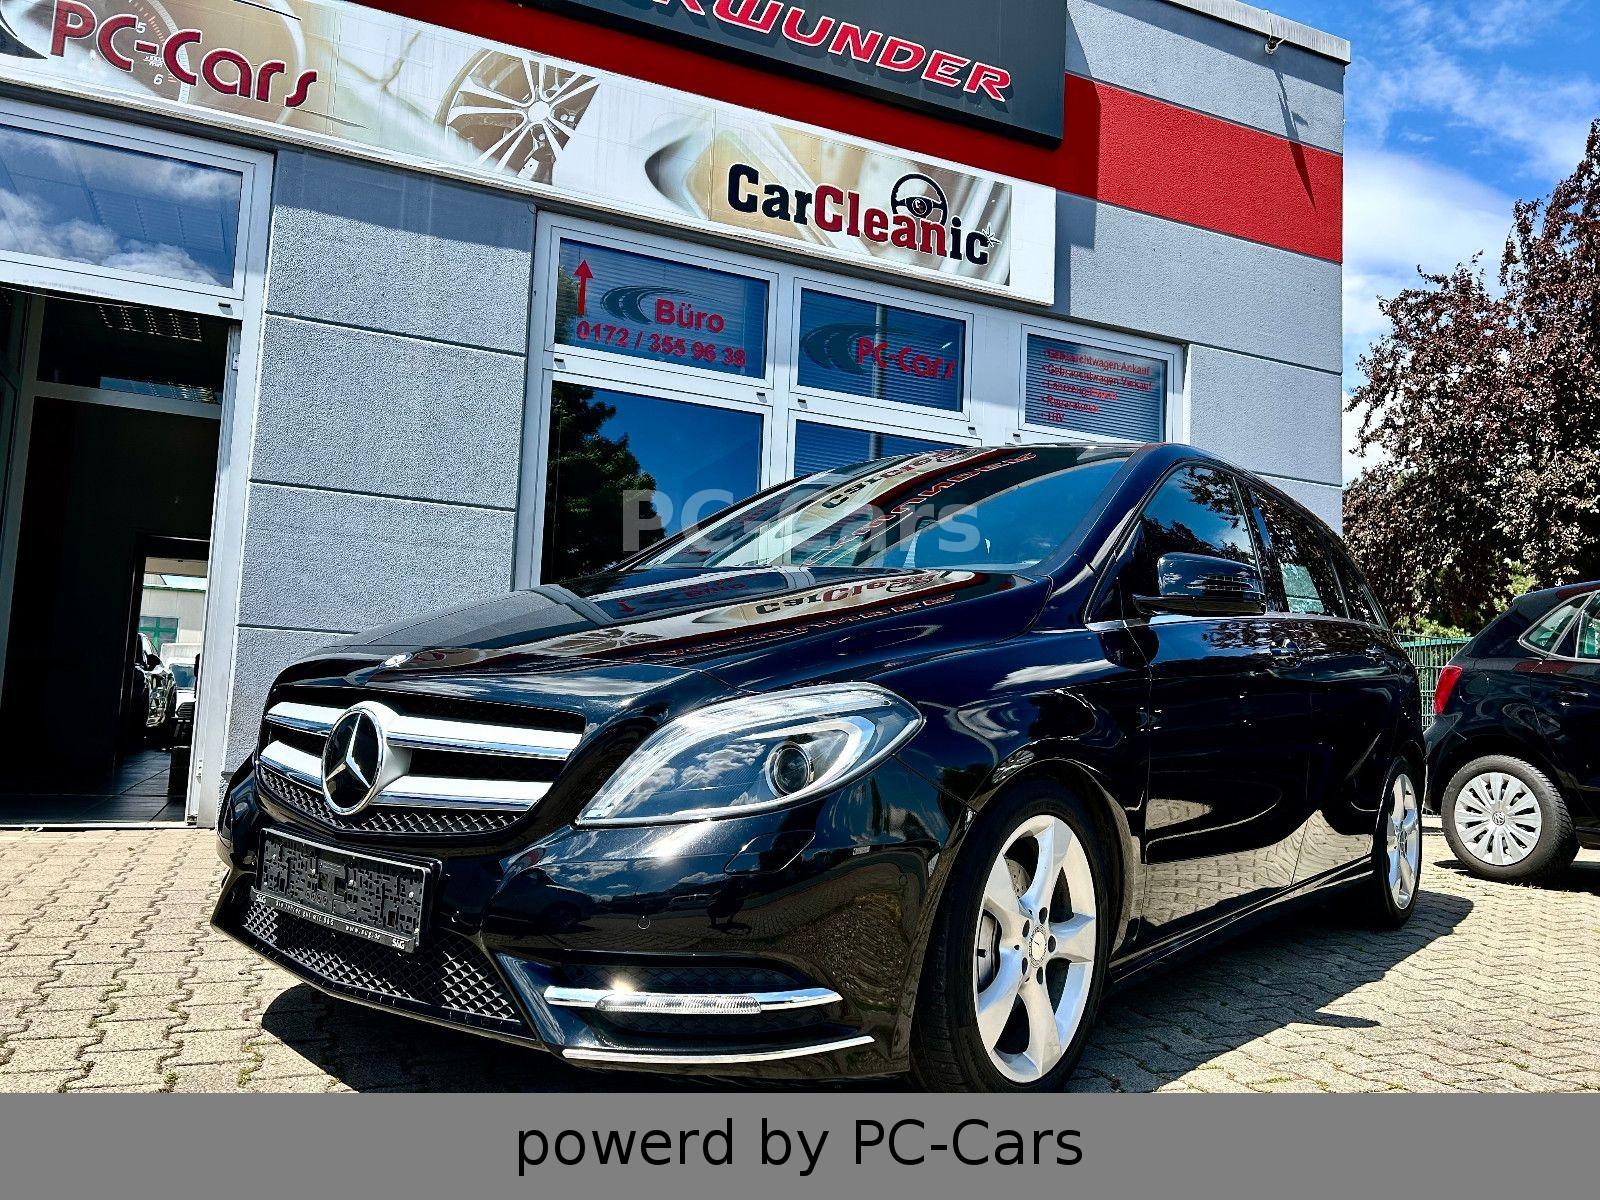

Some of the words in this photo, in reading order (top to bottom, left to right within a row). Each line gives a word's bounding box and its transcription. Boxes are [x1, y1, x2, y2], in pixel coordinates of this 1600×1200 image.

[50, 0, 317, 107] PC-Cars
[728, 163, 990, 266] CarCleanic
[655, 298, 725, 333] Büro
[576, 320, 629, 347] 0172
[648, 333, 686, 357] 355
[691, 341, 716, 362] 96
[721, 346, 746, 368] 38
[857, 336, 956, 379] PC-Cars
